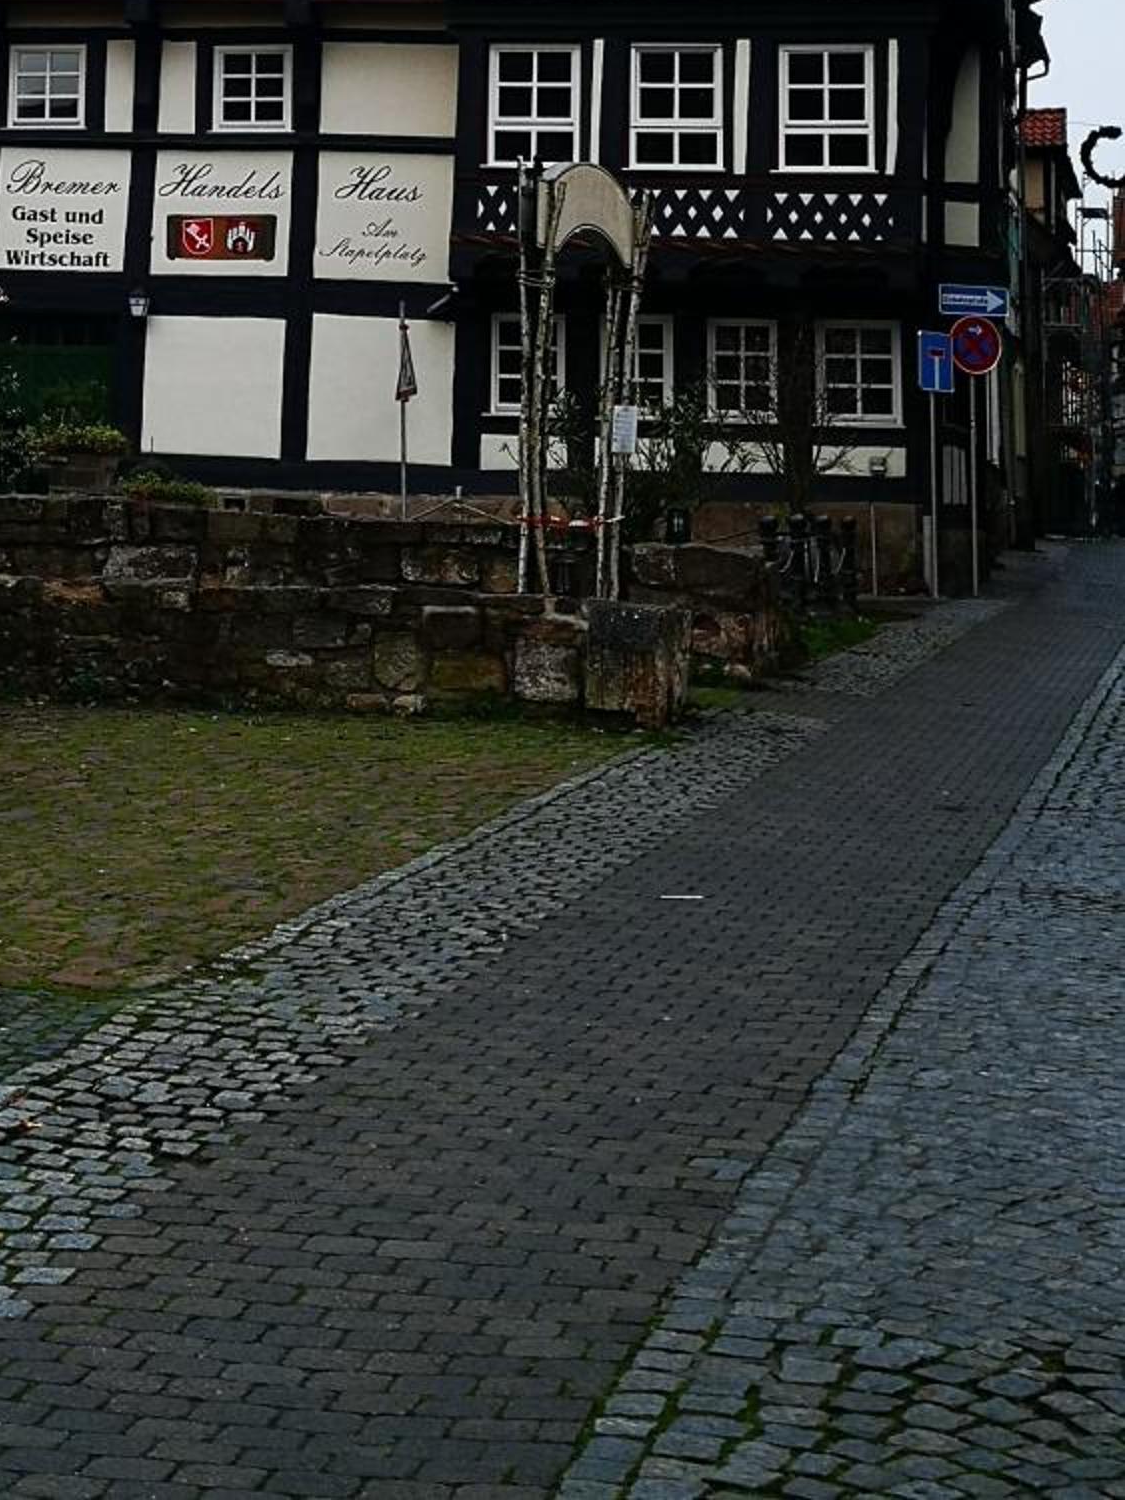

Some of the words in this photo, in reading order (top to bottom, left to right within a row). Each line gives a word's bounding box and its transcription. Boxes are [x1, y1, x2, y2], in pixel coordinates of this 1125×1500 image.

[6, 159, 121, 196] Bremer
[158, 163, 285, 199] Handels
[334, 165, 423, 202] Haus
[12, 205, 57, 223] Gast
[65, 208, 104, 224] und
[26, 227, 94, 248] Speise
[362, 219, 397, 238] Am
[5, 249, 111, 267] Wirtschaft
